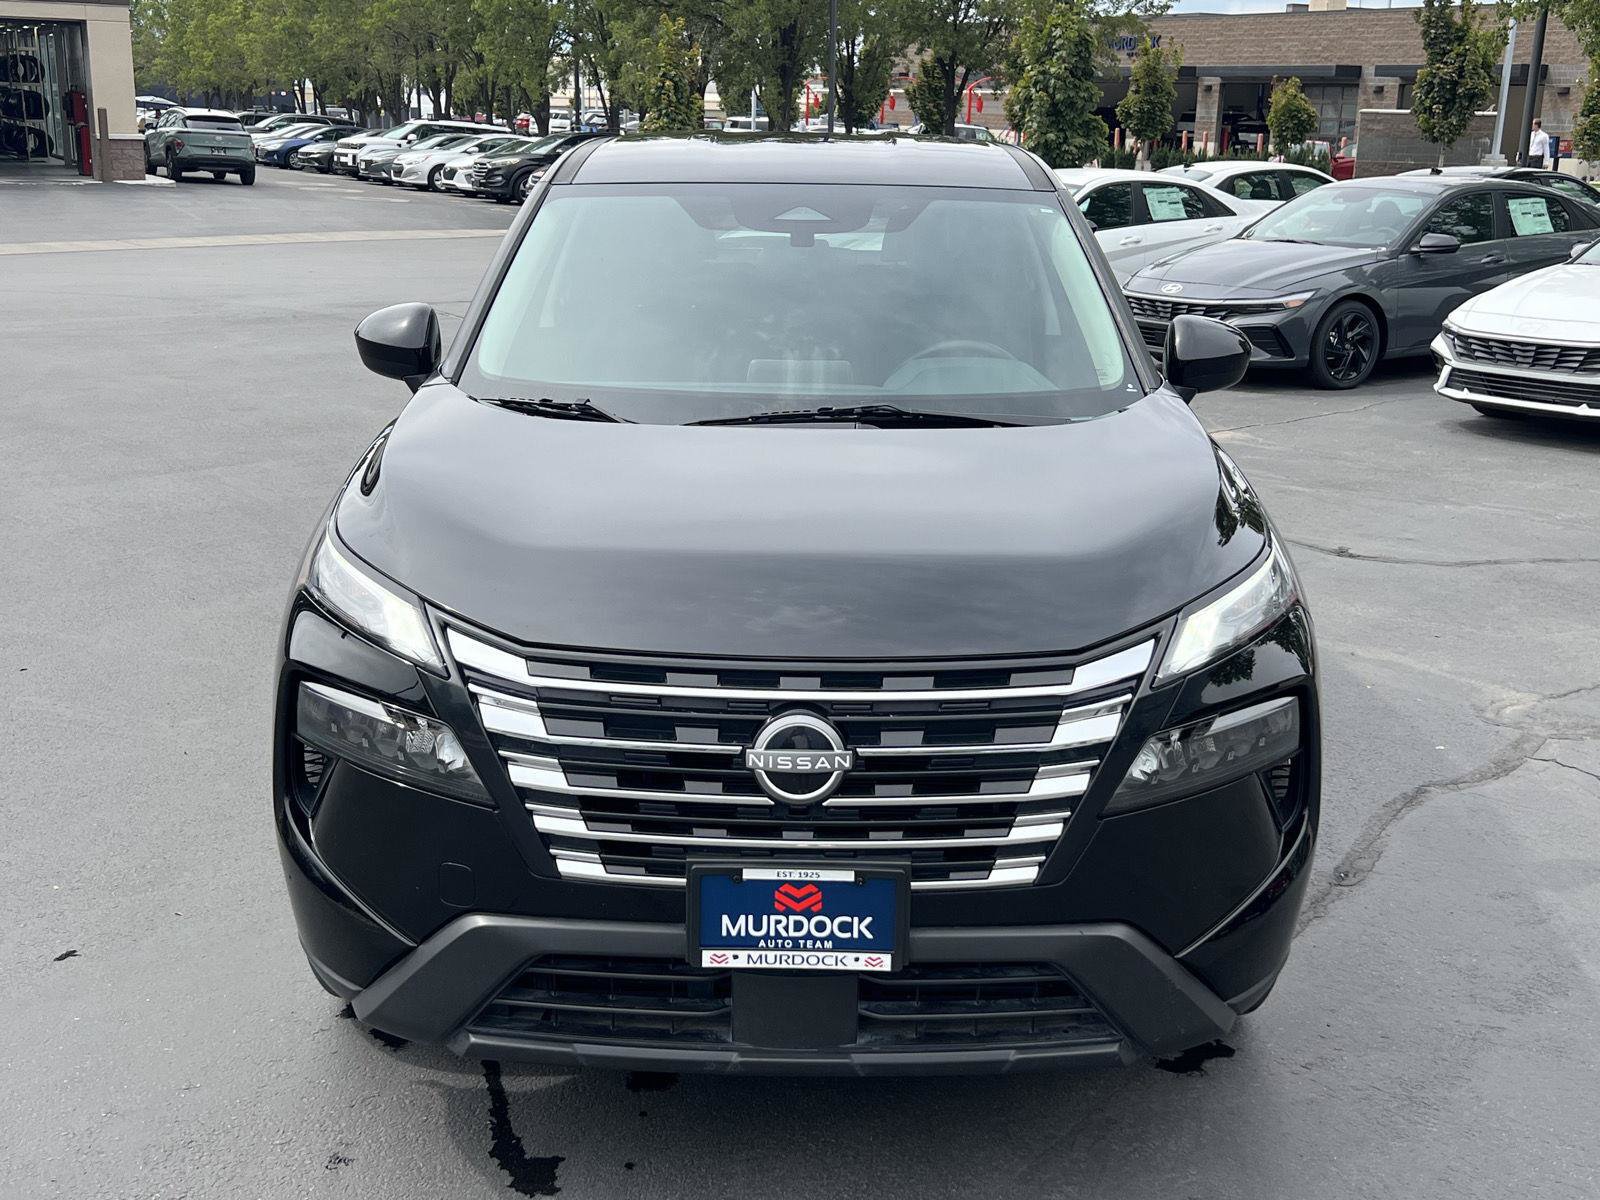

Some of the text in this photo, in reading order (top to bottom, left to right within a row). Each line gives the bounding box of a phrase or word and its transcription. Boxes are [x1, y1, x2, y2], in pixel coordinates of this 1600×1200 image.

[748, 753, 850, 770] NISSAN
[798, 871, 820, 879] 1925
[721, 914, 874, 939] MURDOCK
[758, 939, 833, 949] AUTO TEAM
[747, 953, 848, 967] MURDOCK
